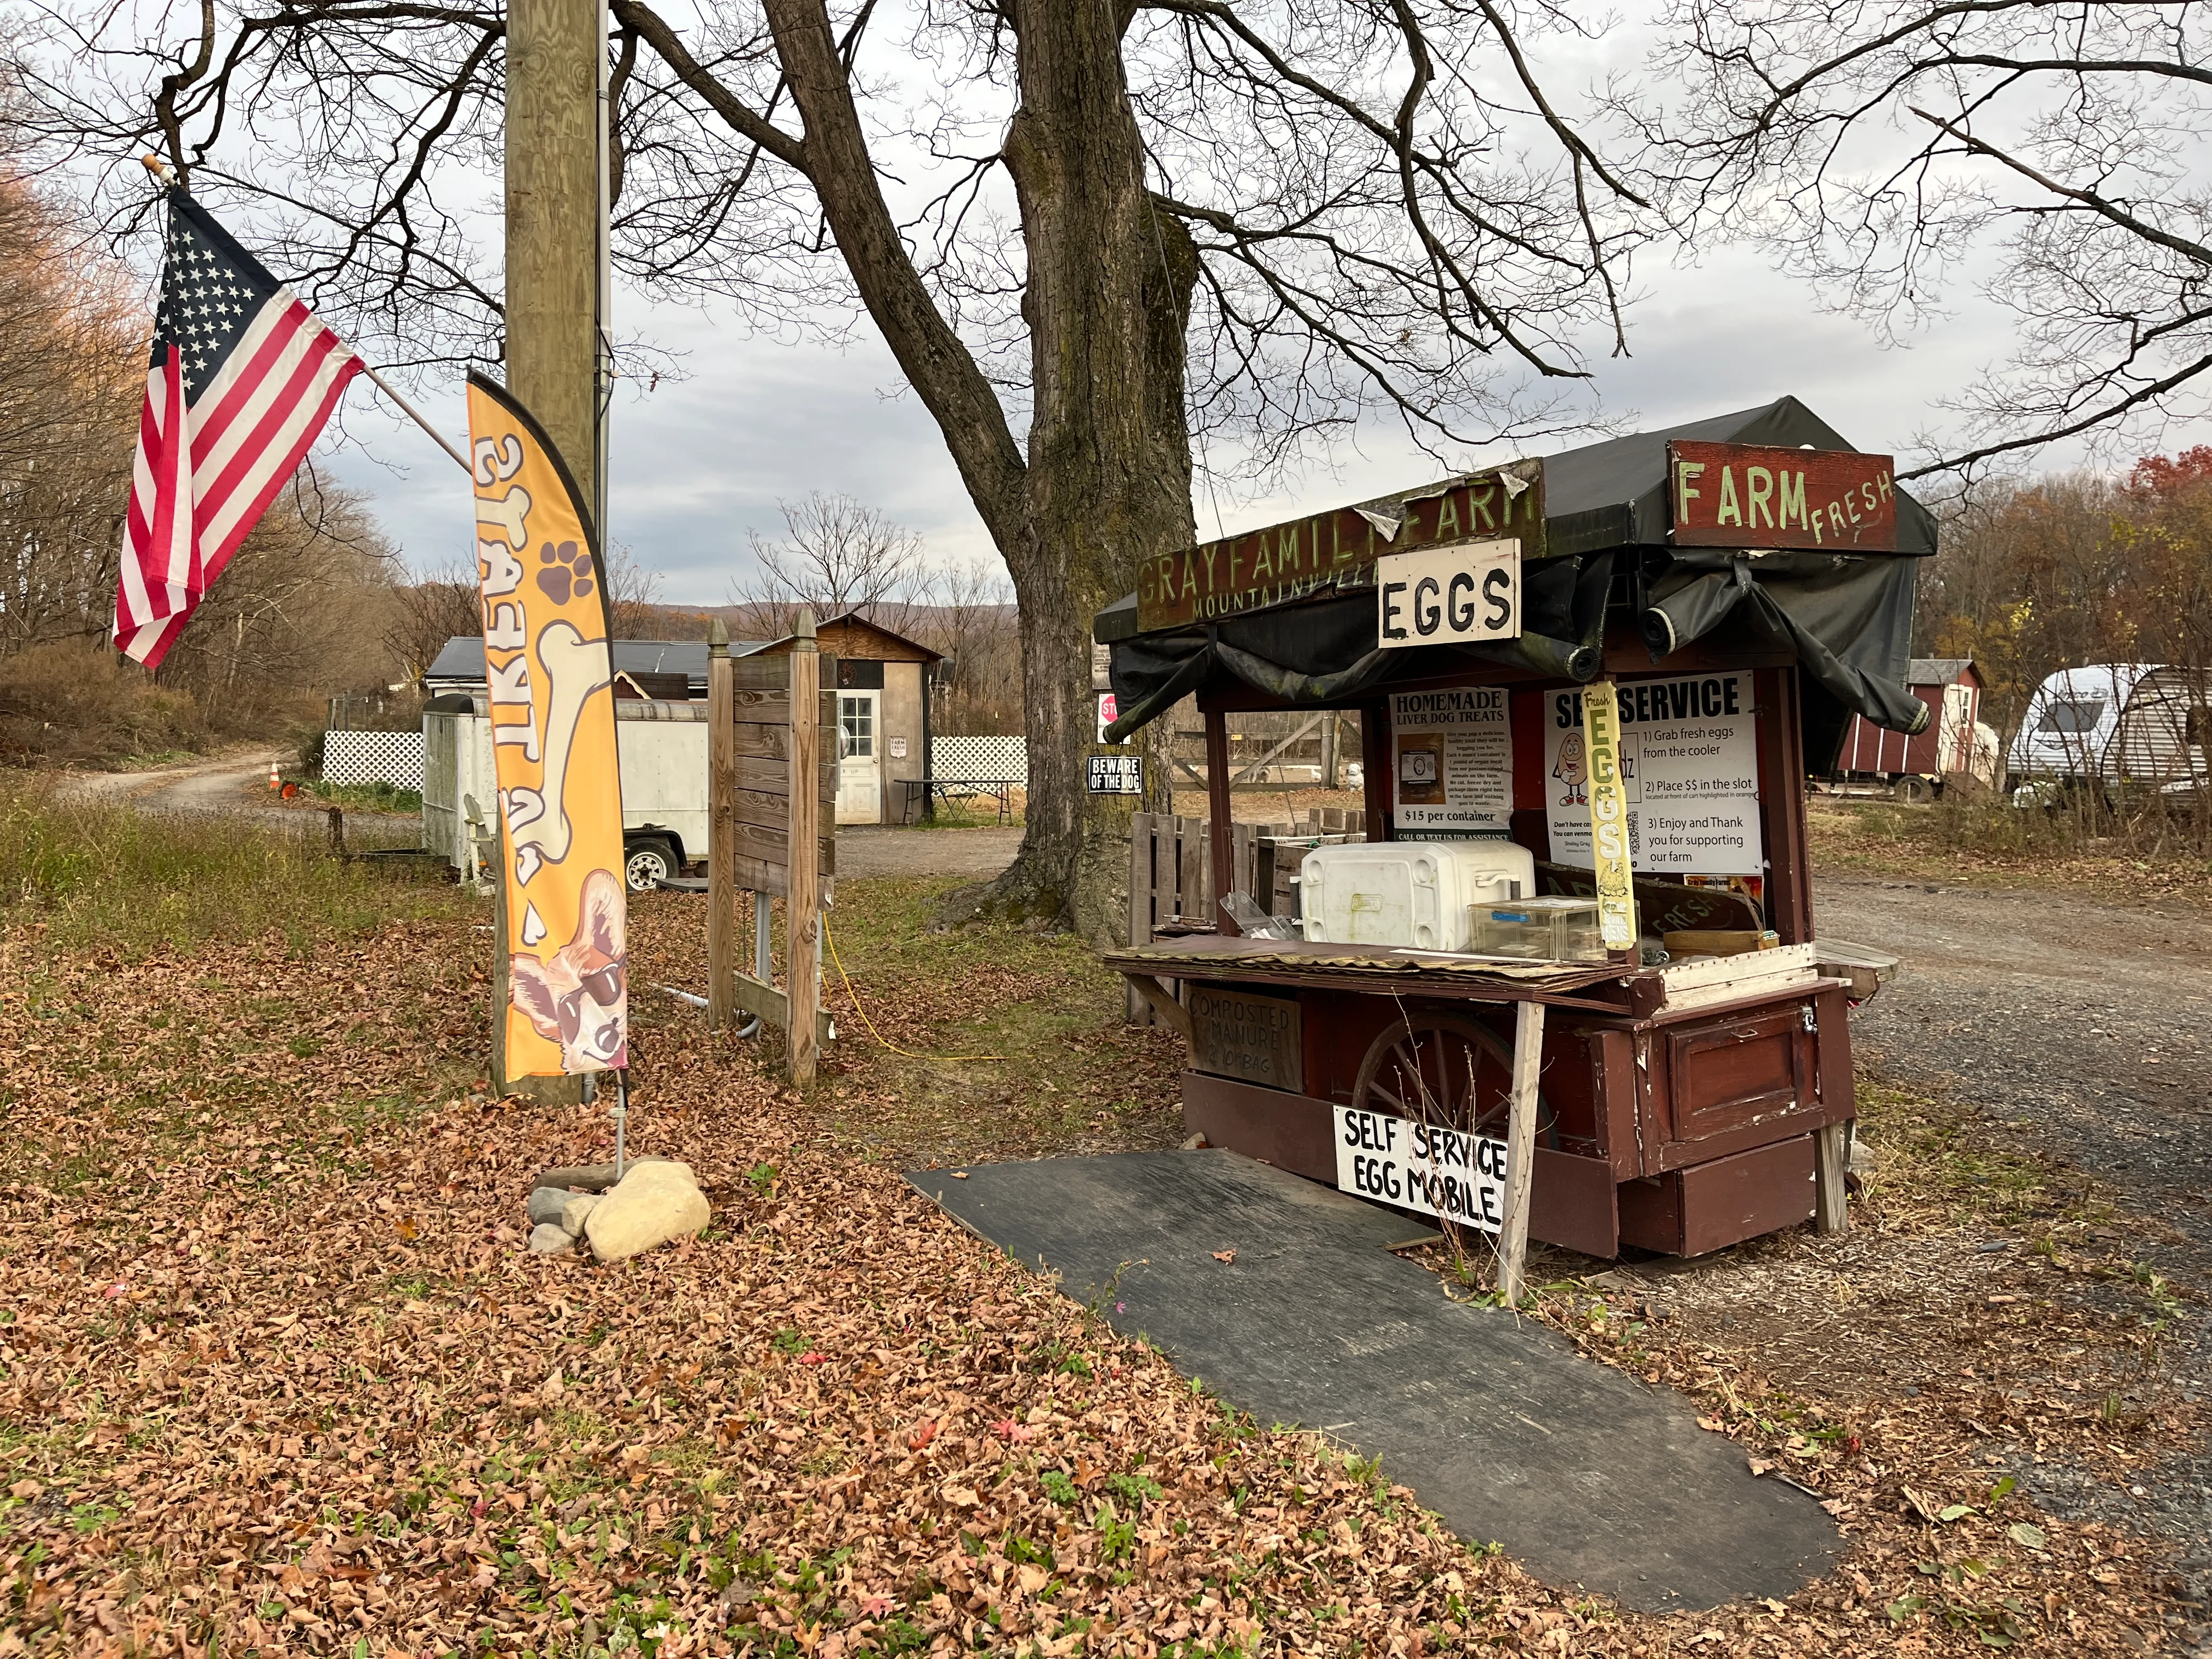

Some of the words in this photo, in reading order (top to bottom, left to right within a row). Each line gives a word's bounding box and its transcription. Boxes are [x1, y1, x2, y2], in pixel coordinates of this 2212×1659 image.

[1679, 462, 1809, 531] FARM
[1811, 470, 1894, 545] FRESH
[1139, 543, 1219, 603] GRAY
[1382, 568, 1511, 641] EGGS
[1396, 691, 1503, 713] HOMEMADE
[1555, 693, 1584, 729] SE
[1617, 677, 1740, 724] SERVICE
[1583, 692, 1611, 708] Fresh
[1102, 703, 1118, 715] ST
[1397, 714, 1427, 725] LIVER
[1431, 712, 1455, 724] DOG
[1458, 710, 1504, 722] TREATS
[1643, 730, 1652, 743] 1)
[1654, 729, 1678, 741] Grab
[1680, 727, 1706, 739] fresh
[1708, 727, 1734, 740] eggs
[1644, 747, 1667, 759] from
[1669, 746, 1686, 757] the
[1688, 743, 1720, 756] cooler
[1092, 759, 1138, 774] BEWARE
[1091, 774, 1102, 789] OF
[1103, 774, 1120, 789] THE
[1121, 774, 1140, 789] DOG
[1589, 708, 1622, 860] EGGS
[1645, 781, 1655, 793] 2)
[1657, 780, 1683, 791] Place
[1685, 779, 1697, 791] $$
[1700, 779, 1710, 790] in
[1712, 778, 1730, 789] the
[1733, 777, 1752, 789] slot
[1700, 792, 1729, 800] highlighted
[1405, 810, 1424, 822] $15
[1427, 812, 1444, 823] per
[1447, 810, 1496, 822] container
[1648, 818, 1657, 830] 3)
[1660, 817, 1687, 831] Enjoy
[1689, 817, 1708, 828] and
[1710, 816, 1743, 827] Thank
[1649, 837, 1667, 848] you
[1669, 834, 1684, 845] for
[1686, 834, 1743, 848] supporting
[1650, 853, 1667, 862] our
[1669, 851, 1692, 862] farm
[1605, 925, 1629, 941] HENS
[1189, 993, 1289, 1030] COMPOSTED
[1211, 1019, 1279, 1051] MANURE
[1242, 1053, 1271, 1073] BAG
[1345, 1110, 1398, 1153] SELF
[1413, 1123, 1508, 1181] SERVICE
[1354, 1154, 1401, 1200] EGG
[1407, 1167, 1503, 1226] MOBILE
